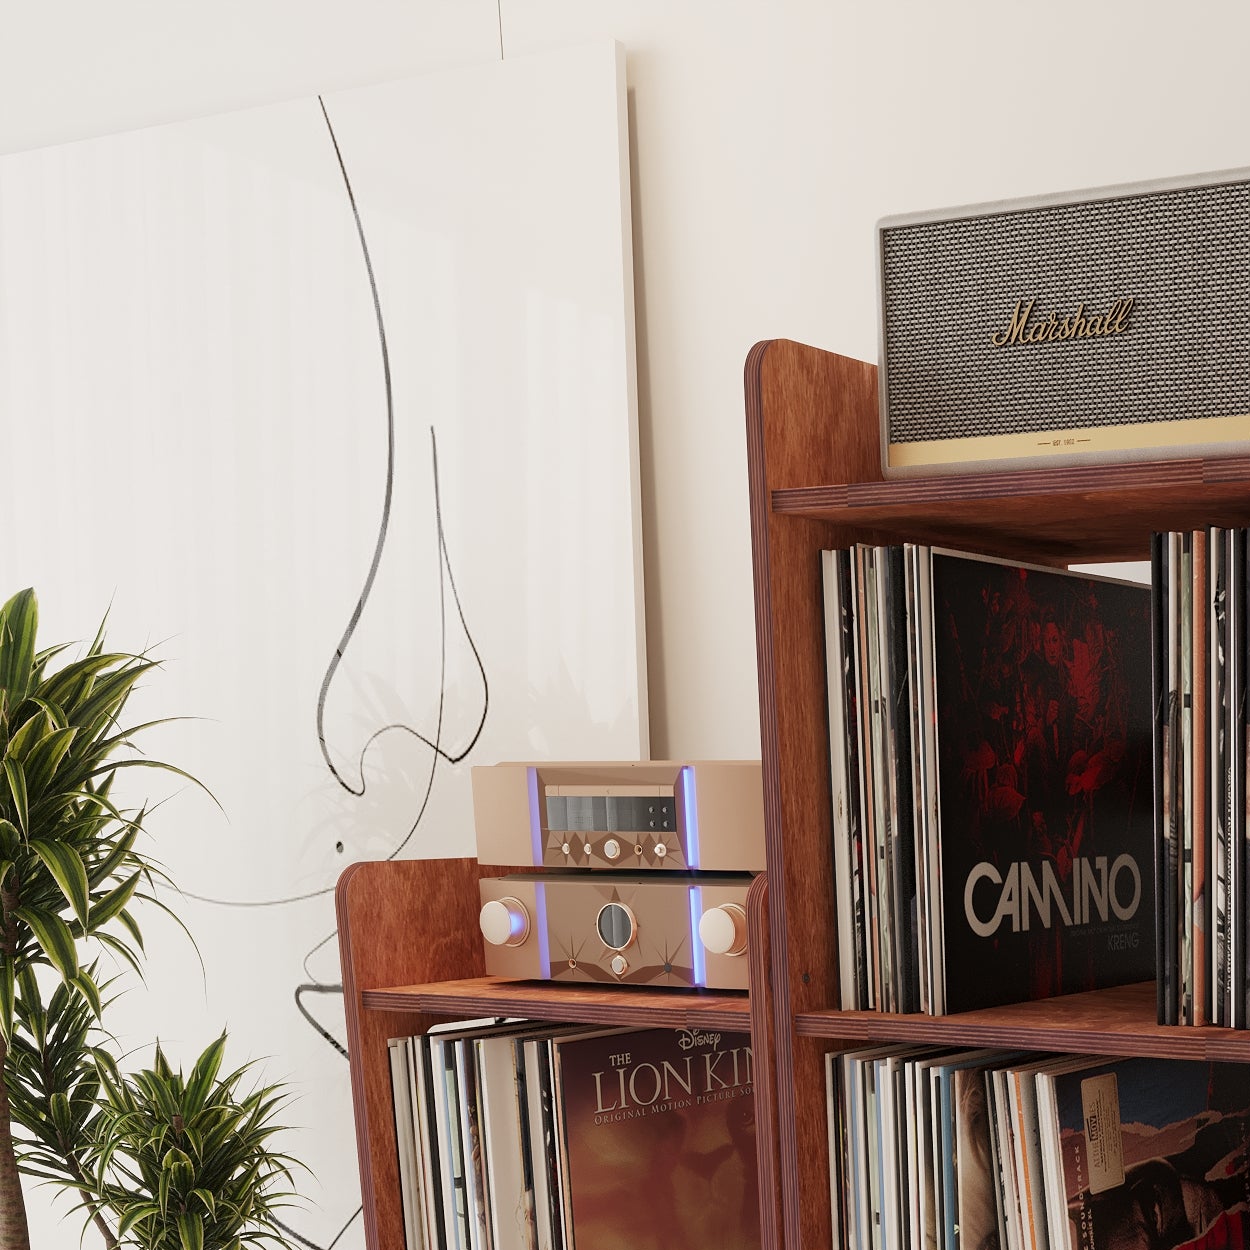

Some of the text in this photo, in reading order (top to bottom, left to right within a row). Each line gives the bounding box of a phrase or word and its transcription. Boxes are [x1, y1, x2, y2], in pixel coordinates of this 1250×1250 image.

[991, 297, 1134, 346] Marshall
[963, 853, 1142, 938] CAMINO
[1107, 932, 1140, 950] KRENG
[609, 1053, 632, 1067] THE
[592, 1056, 692, 1114] LION
[594, 1108, 647, 1127] ORIGINAL
[651, 1098, 692, 1114] MOTION
[696, 1089, 736, 1106] PICTURE
[1074, 1145, 1087, 1239] SOUNDTRACK
[1087, 1208, 1093, 1220] XL
